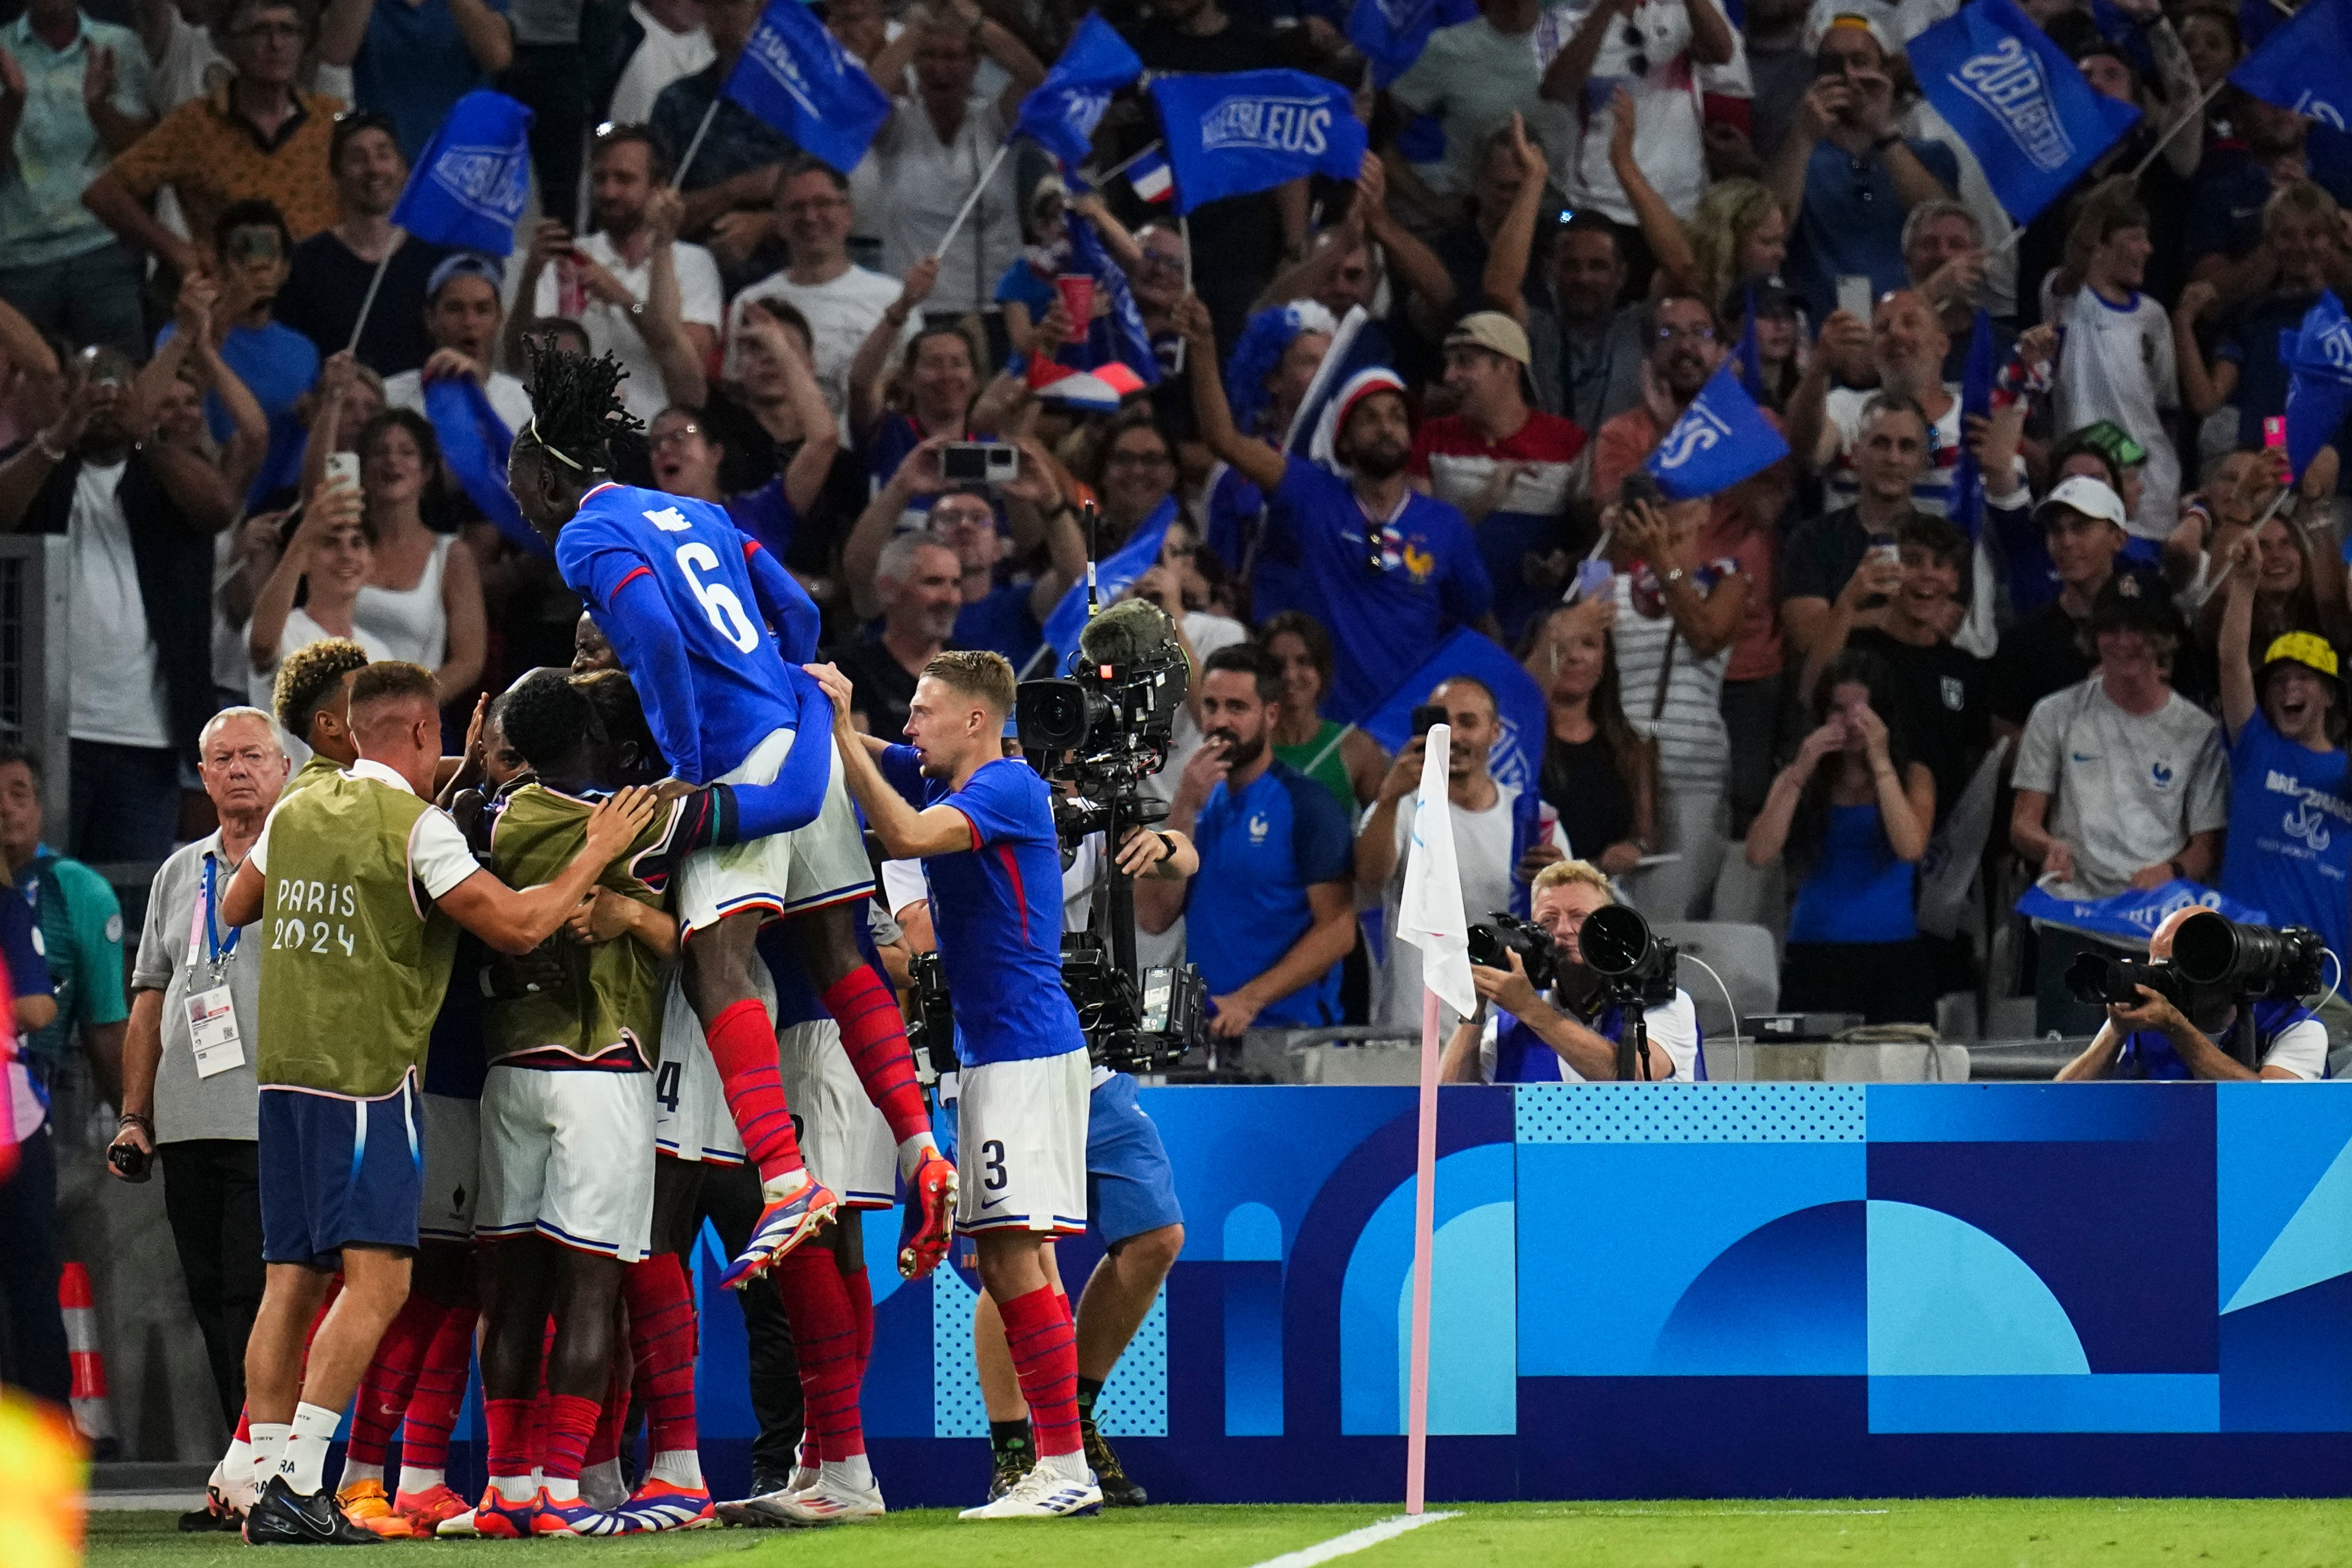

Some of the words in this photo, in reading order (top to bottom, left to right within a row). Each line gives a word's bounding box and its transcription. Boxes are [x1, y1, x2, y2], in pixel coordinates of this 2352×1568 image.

[676, 542, 759, 654] 6
[271, 918, 354, 957] 2024
[656, 1061, 681, 1113] 4
[982, 1140, 1007, 1190] 3
